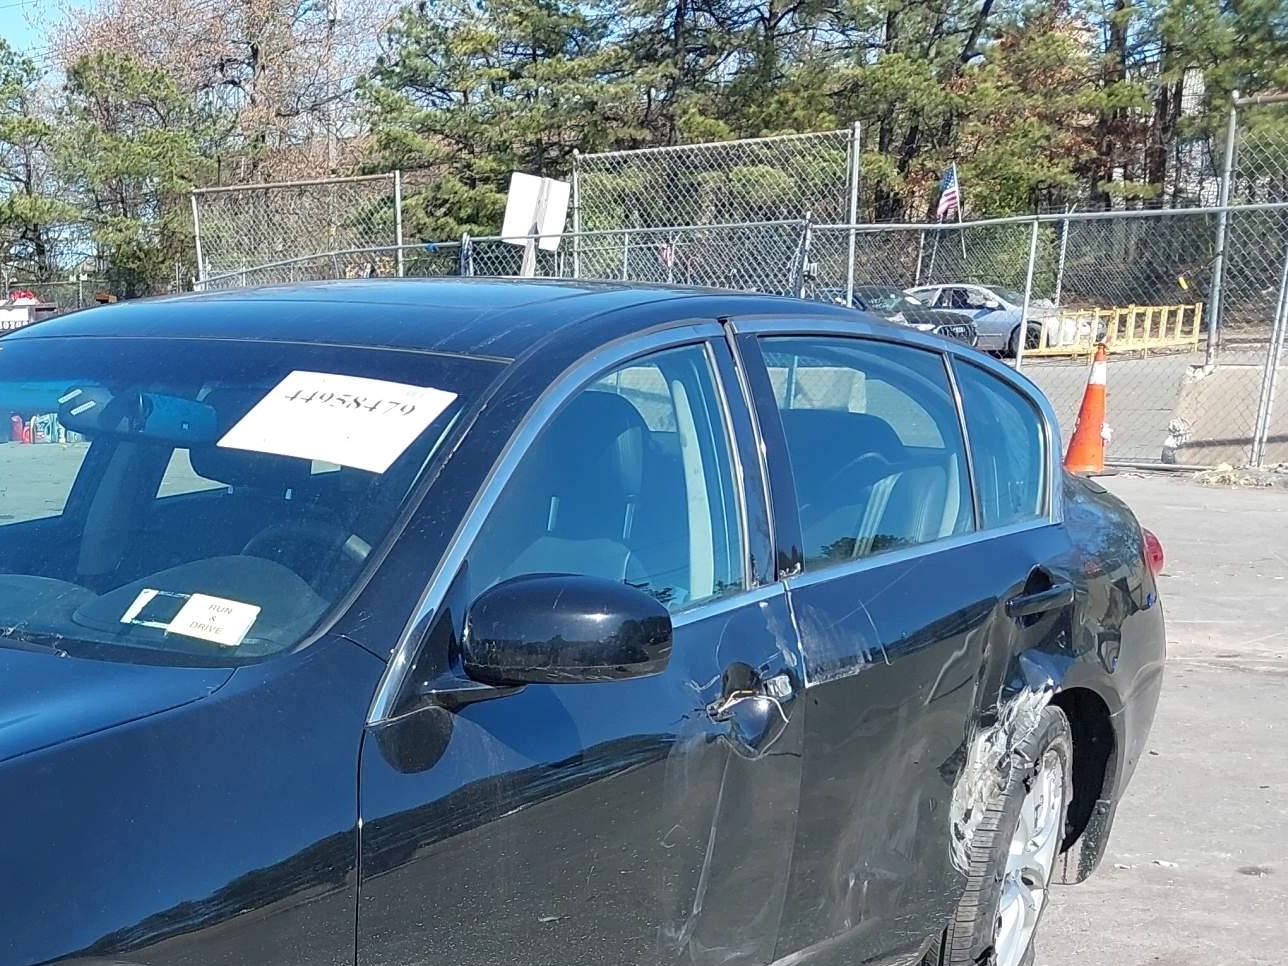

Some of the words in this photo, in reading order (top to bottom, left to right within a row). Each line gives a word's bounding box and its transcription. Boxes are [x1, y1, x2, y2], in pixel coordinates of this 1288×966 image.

[284, 389, 416, 416] 44958479
[208, 603, 233, 615] RUN
[189, 620, 225, 635] DRIVE
